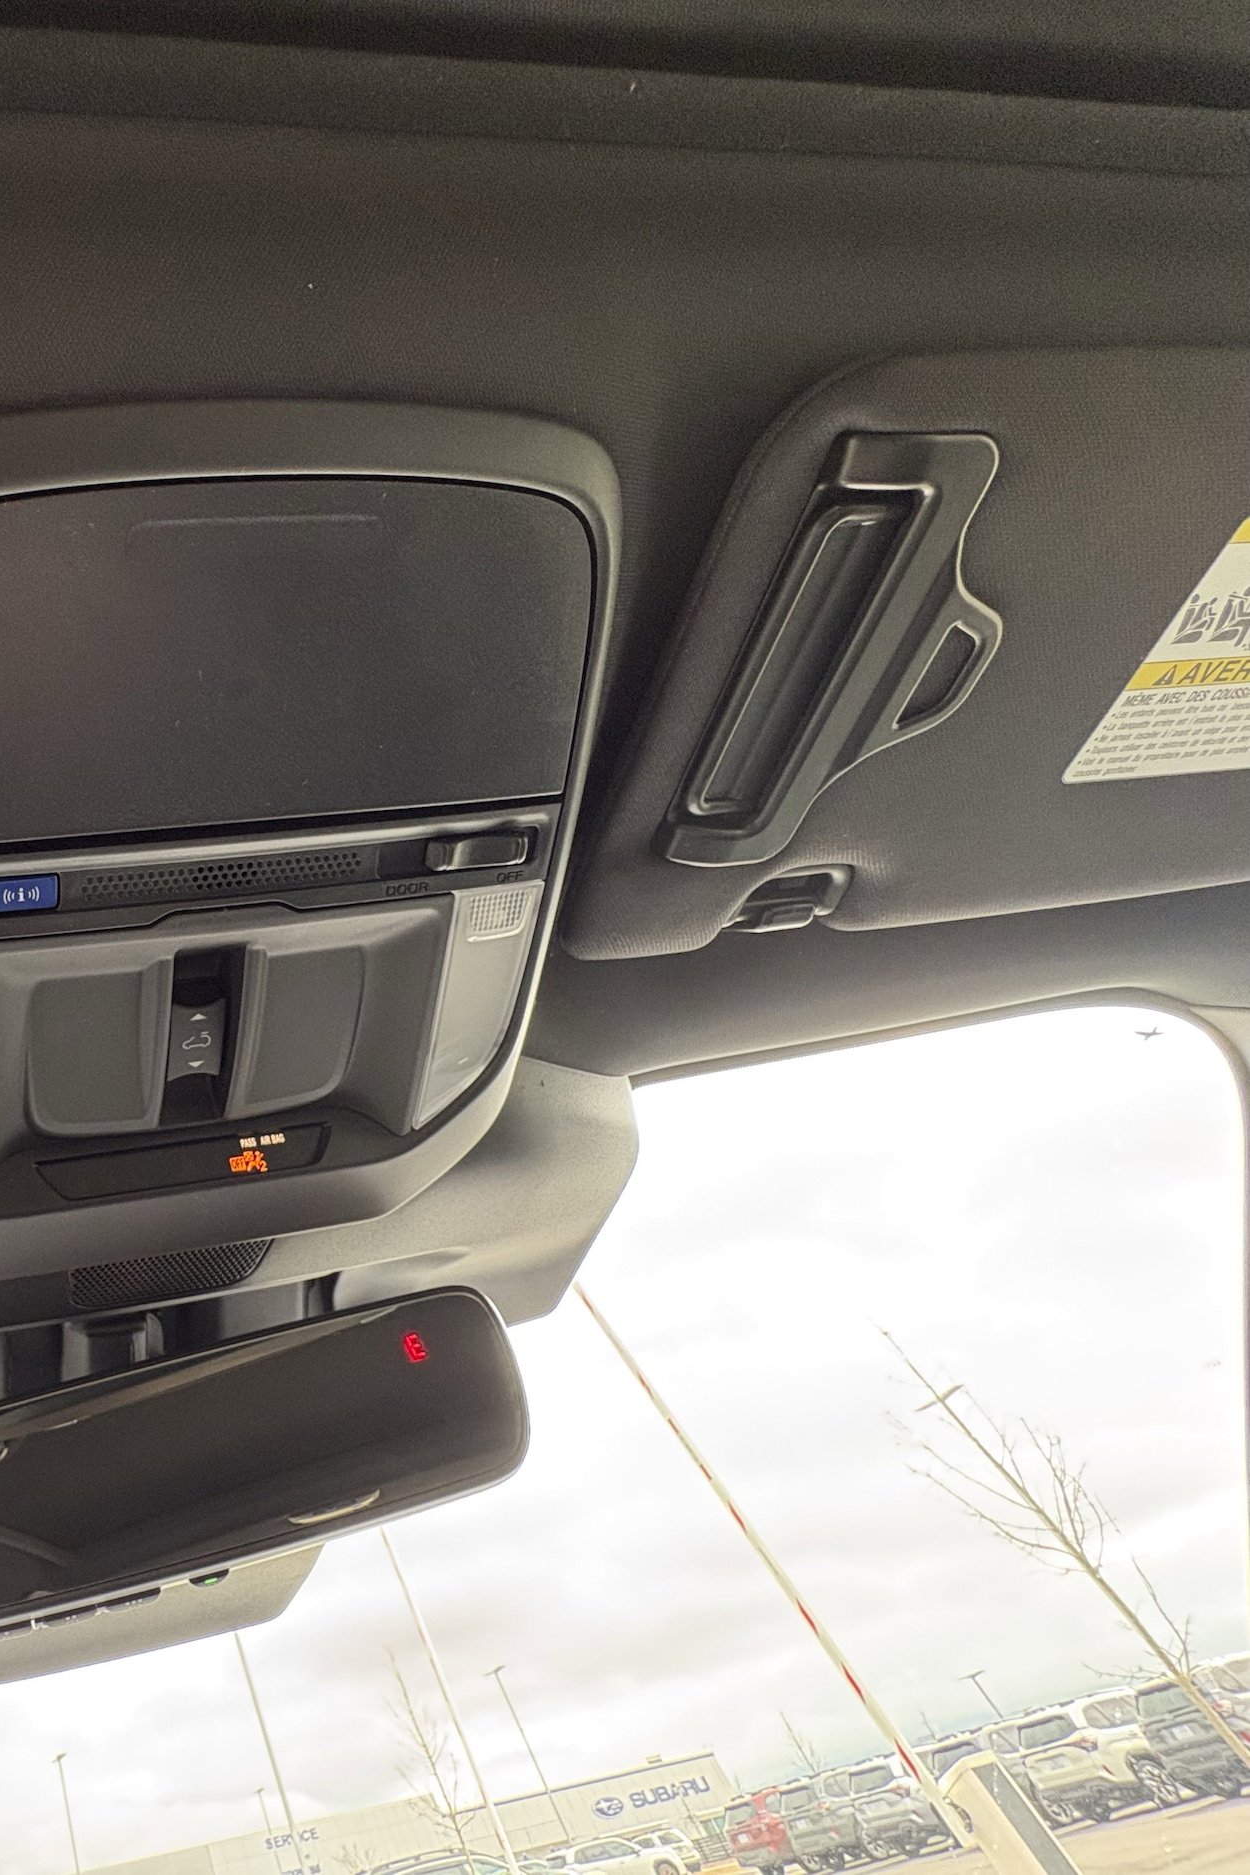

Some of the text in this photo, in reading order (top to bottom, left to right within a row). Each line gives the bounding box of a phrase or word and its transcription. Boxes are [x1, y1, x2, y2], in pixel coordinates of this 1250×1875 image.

[1155, 692, 1187, 705] AVEC
[1186, 690, 1211, 703] DES
[496, 870, 524, 883] OFF
[386, 882, 428, 896] DOOR
[239, 1136, 257, 1149] PASS
[629, 1775, 711, 1808] SUBARU
[265, 1827, 320, 1850] SERICE
